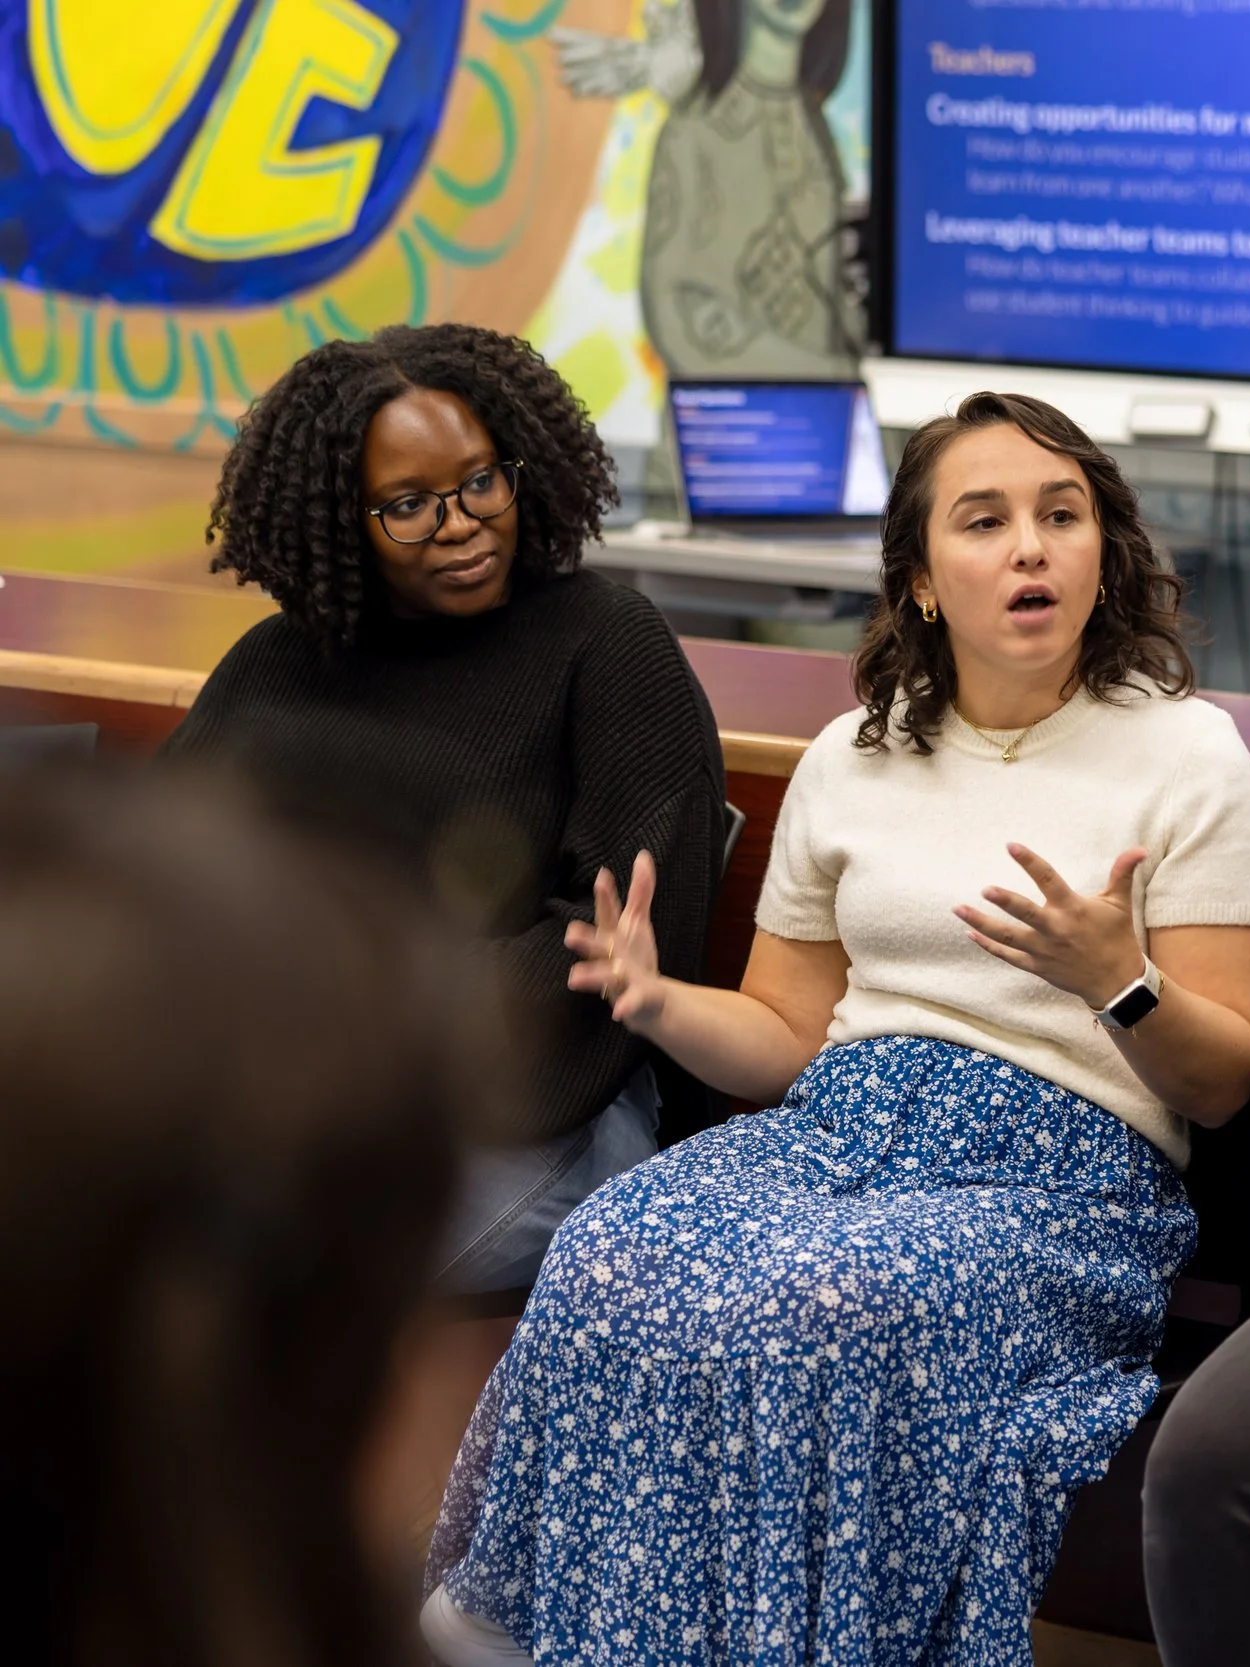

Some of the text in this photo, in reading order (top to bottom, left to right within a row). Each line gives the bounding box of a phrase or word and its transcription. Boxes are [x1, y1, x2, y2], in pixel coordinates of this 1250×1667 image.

[926, 93, 1031, 133] Creating
[1033, 101, 1197, 135] opportunities
[1200, 104, 1237, 135] for
[926, 210, 1055, 252] Leveraging
[1057, 219, 1148, 251] teacher
[1152, 223, 1228, 256] teams
